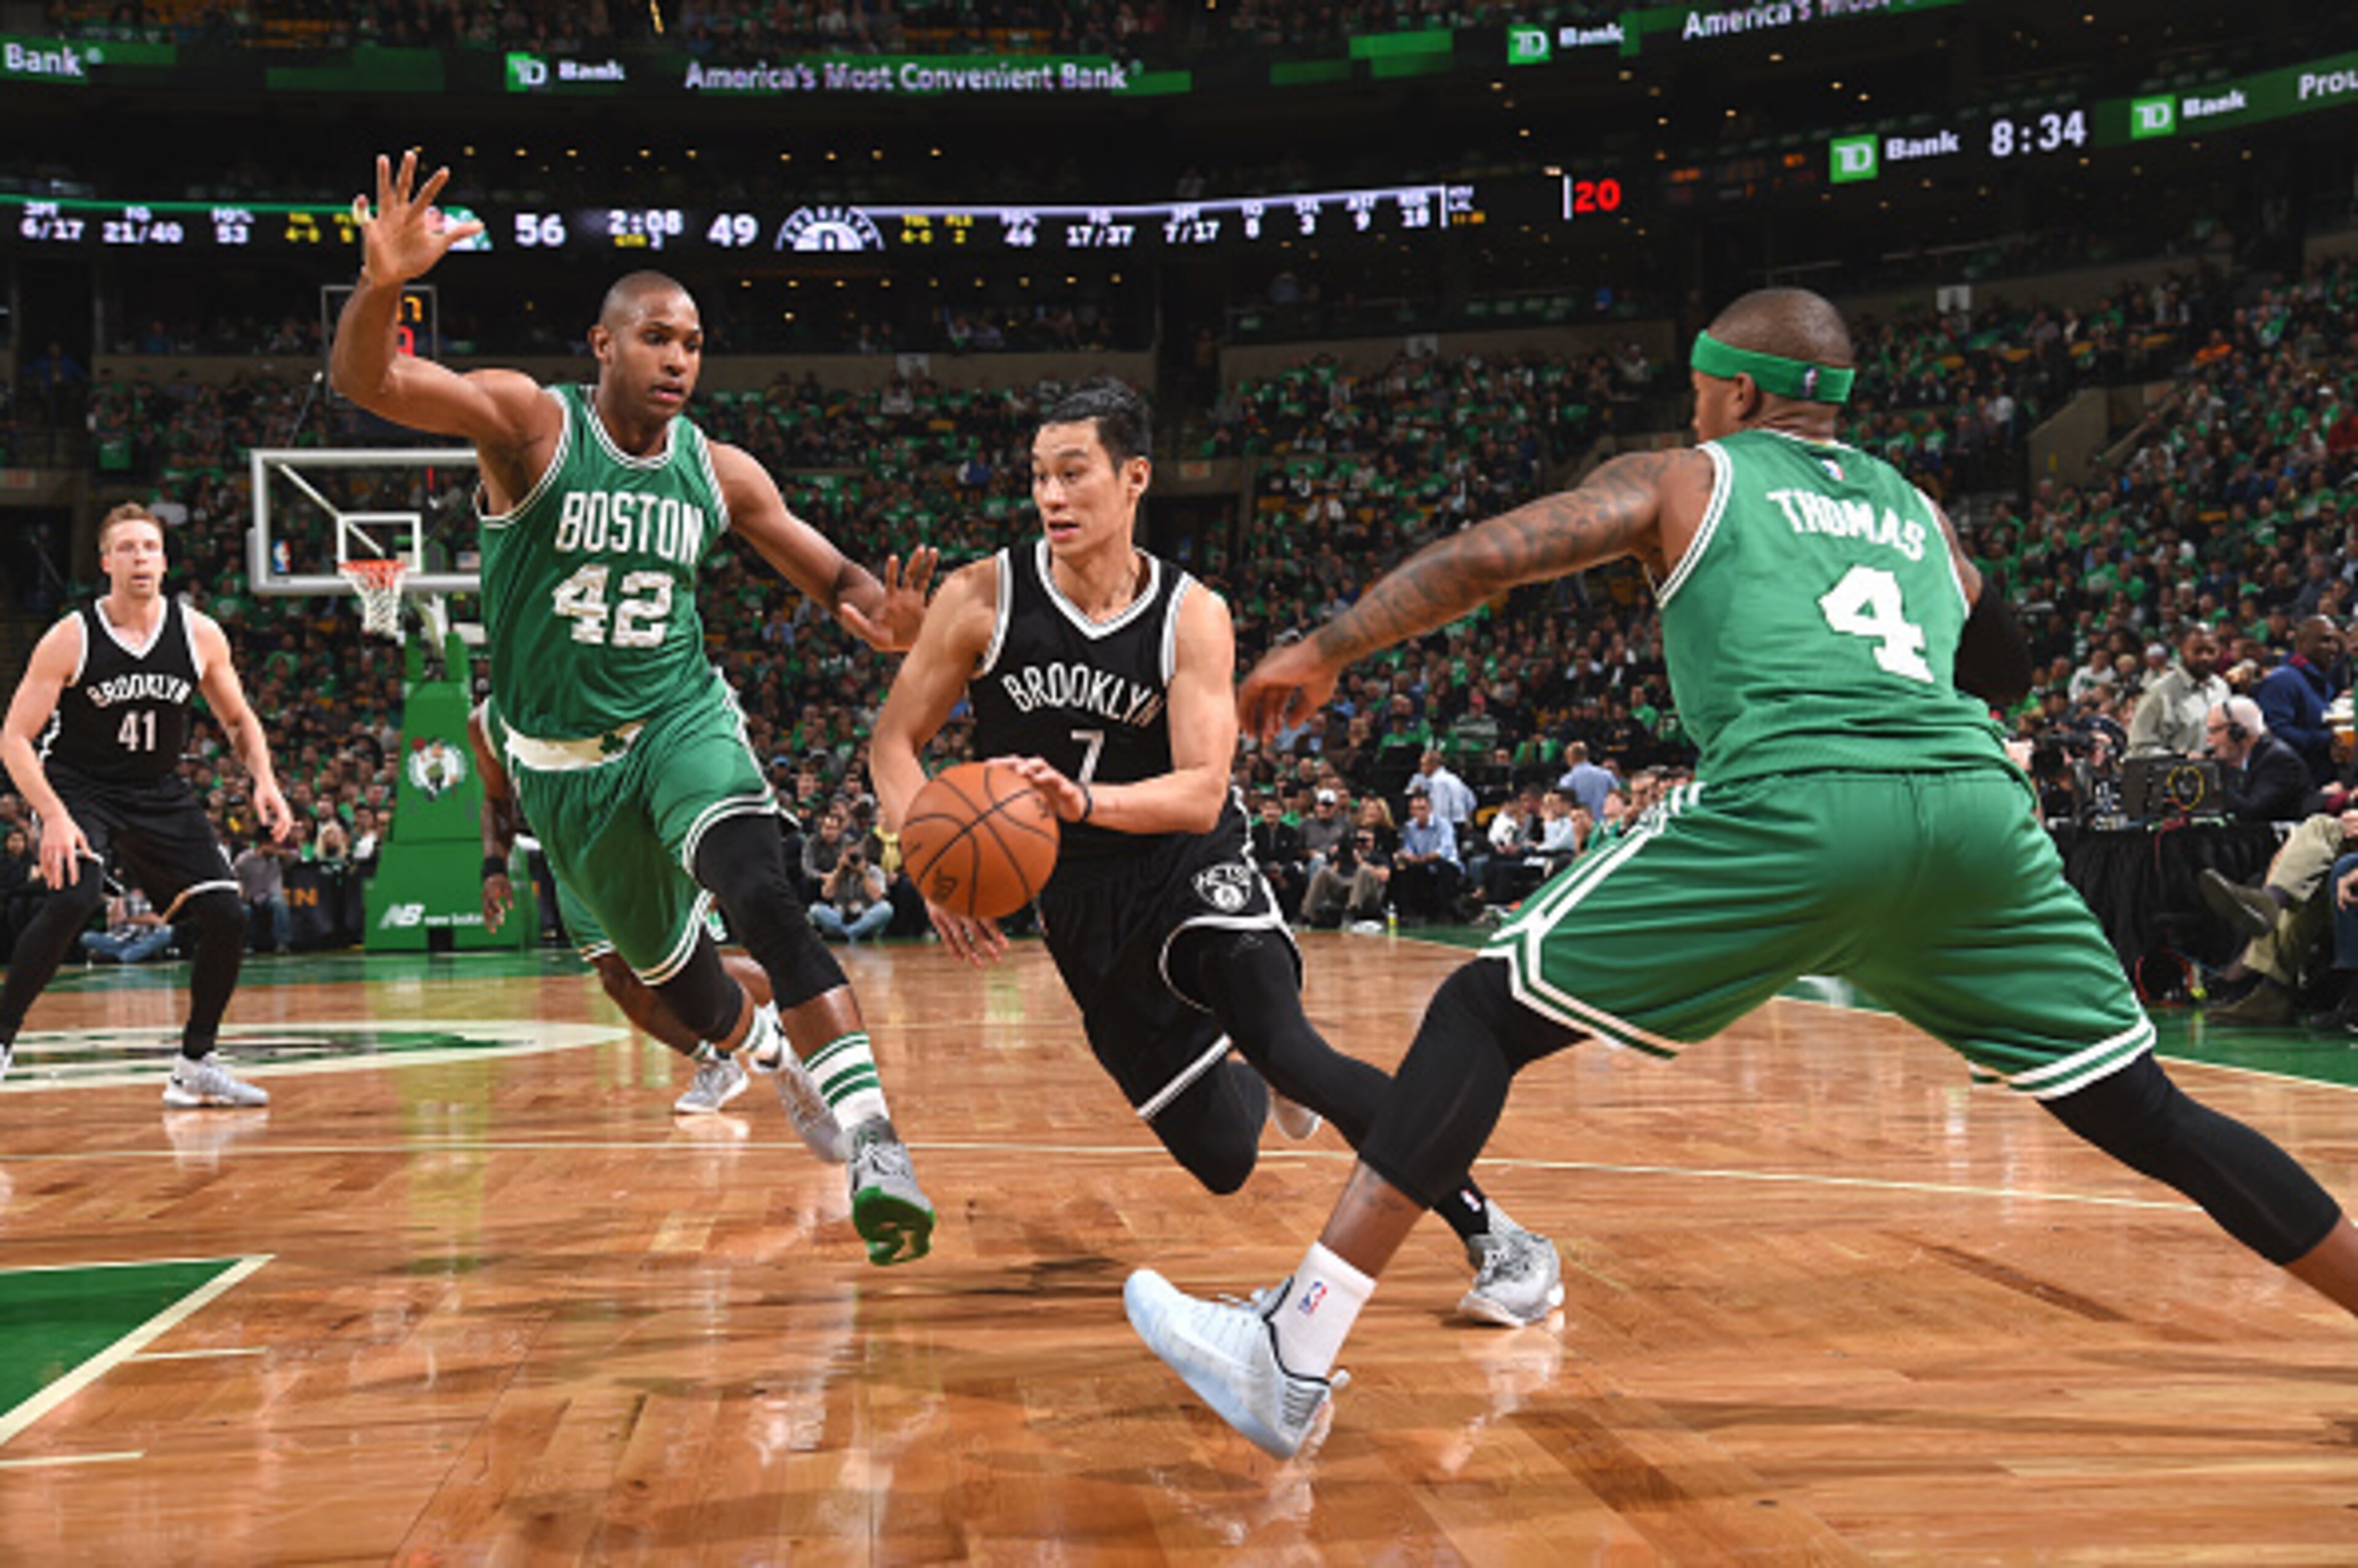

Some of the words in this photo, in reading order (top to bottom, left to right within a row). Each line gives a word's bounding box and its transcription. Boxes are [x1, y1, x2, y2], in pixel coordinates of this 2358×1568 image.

[1558, 23, 1624, 47] Bank
[1681, 0, 1811, 41] America's
[4, 42, 84, 76] Bank
[558, 60, 625, 80] Bank
[685, 60, 817, 90] America's
[823, 63, 894, 90] Most
[900, 63, 1055, 90] Convenient
[2135, 103, 2173, 130] TD
[2181, 89, 2247, 118] Bank
[1834, 142, 1875, 173] TD
[1885, 130, 1961, 160] Bank
[1989, 111, 2086, 157] 8:34
[1573, 177, 1622, 213] 20
[20, 218, 85, 240] 6/17
[102, 221, 184, 244] 21/40
[515, 212, 566, 247] 56
[607, 209, 683, 235] 2:08
[707, 212, 759, 247] 49
[1066, 225, 1135, 247] 17/37
[1163, 220, 1221, 244] 7/17
[555, 491, 704, 565] BOSTON
[1766, 489, 1926, 561] THOMAS
[551, 564, 675, 648] 42
[1816, 564, 1934, 683] 4
[87, 673, 191, 707] BROOKLYN
[1001, 662, 1164, 727] BROOKLYN
[117, 710, 157, 751] 41
[1070, 729, 1104, 784] 7
